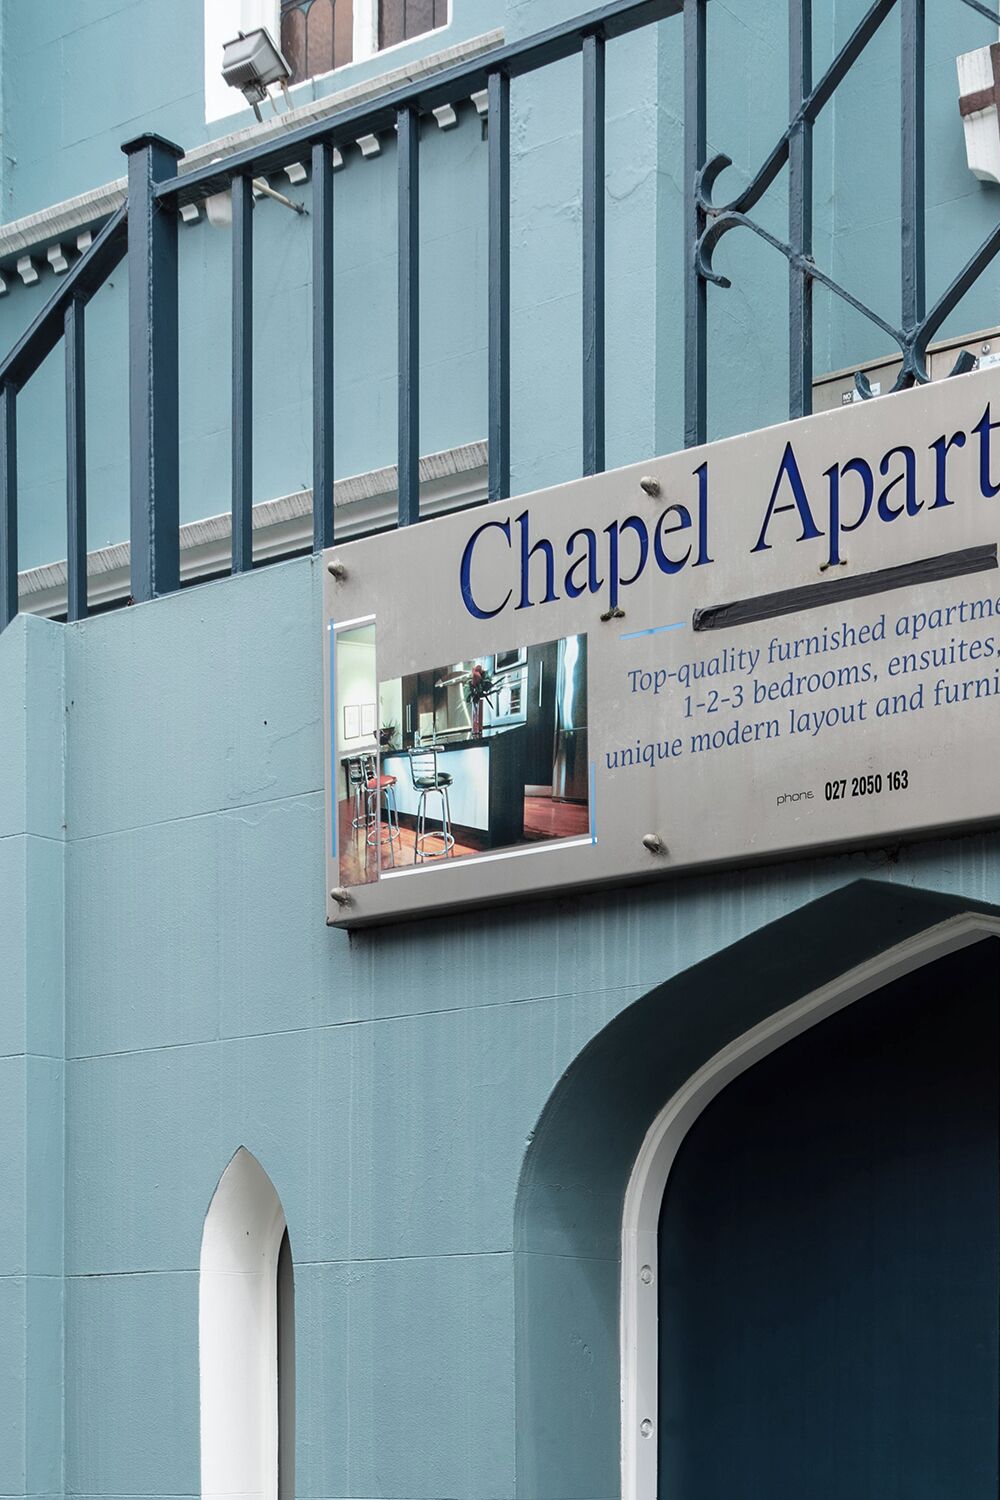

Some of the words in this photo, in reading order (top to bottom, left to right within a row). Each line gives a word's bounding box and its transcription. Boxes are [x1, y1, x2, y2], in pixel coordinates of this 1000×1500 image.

[460, 462, 714, 620] Chapel
[628, 646, 760, 694] Top-quality
[767, 615, 886, 664] furnished
[683, 685, 744, 719] 1-2-3
[753, 662, 878, 704] bedrooms,
[606, 738, 682, 769] unique
[690, 720, 780, 754] modern
[789, 698, 867, 737] layout
[875, 683, 924, 718] and
[776, 790, 815, 806] phone
[824, 779, 847, 801] 027
[851, 774, 882, 797] 2050
[886, 769, 909, 792] 163
